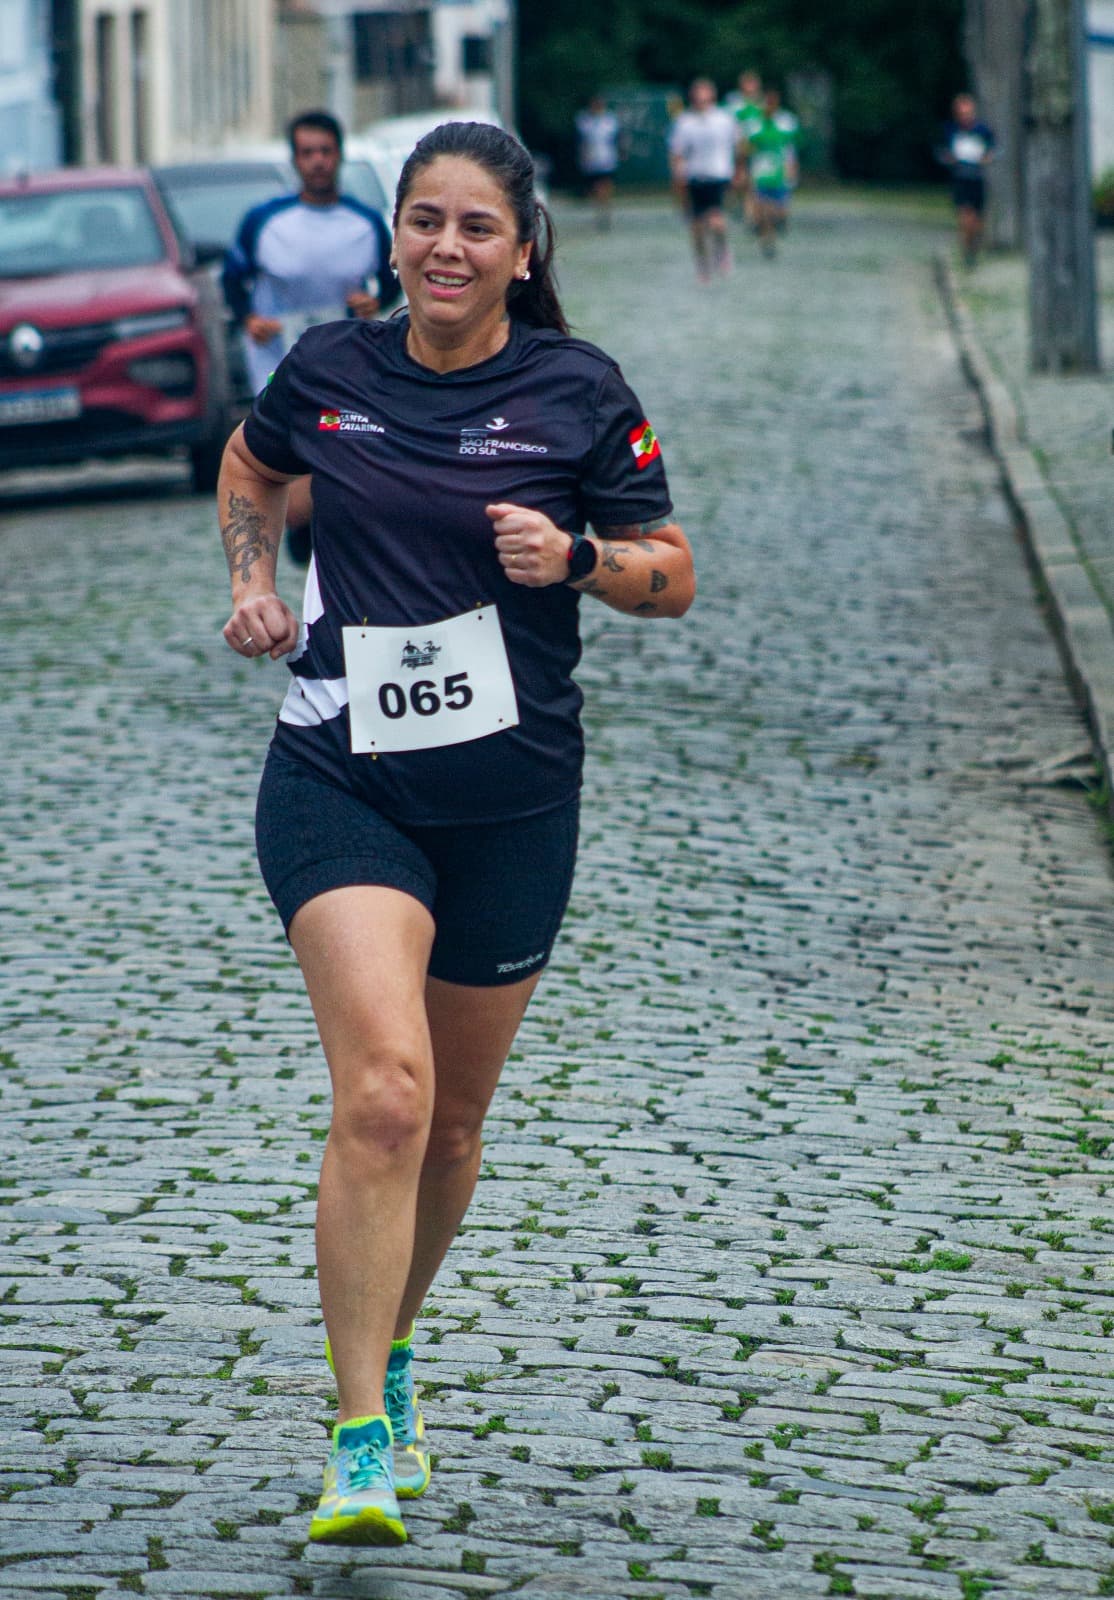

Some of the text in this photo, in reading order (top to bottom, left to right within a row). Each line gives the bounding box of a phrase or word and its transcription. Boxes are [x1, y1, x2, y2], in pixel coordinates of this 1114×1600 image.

[340, 413, 369, 423] SANTA
[340, 422, 385, 433] CATARINA
[459, 446, 499, 456] DO SUL
[484, 439, 548, 454] FRANCISCO
[378, 672, 473, 719] 065
